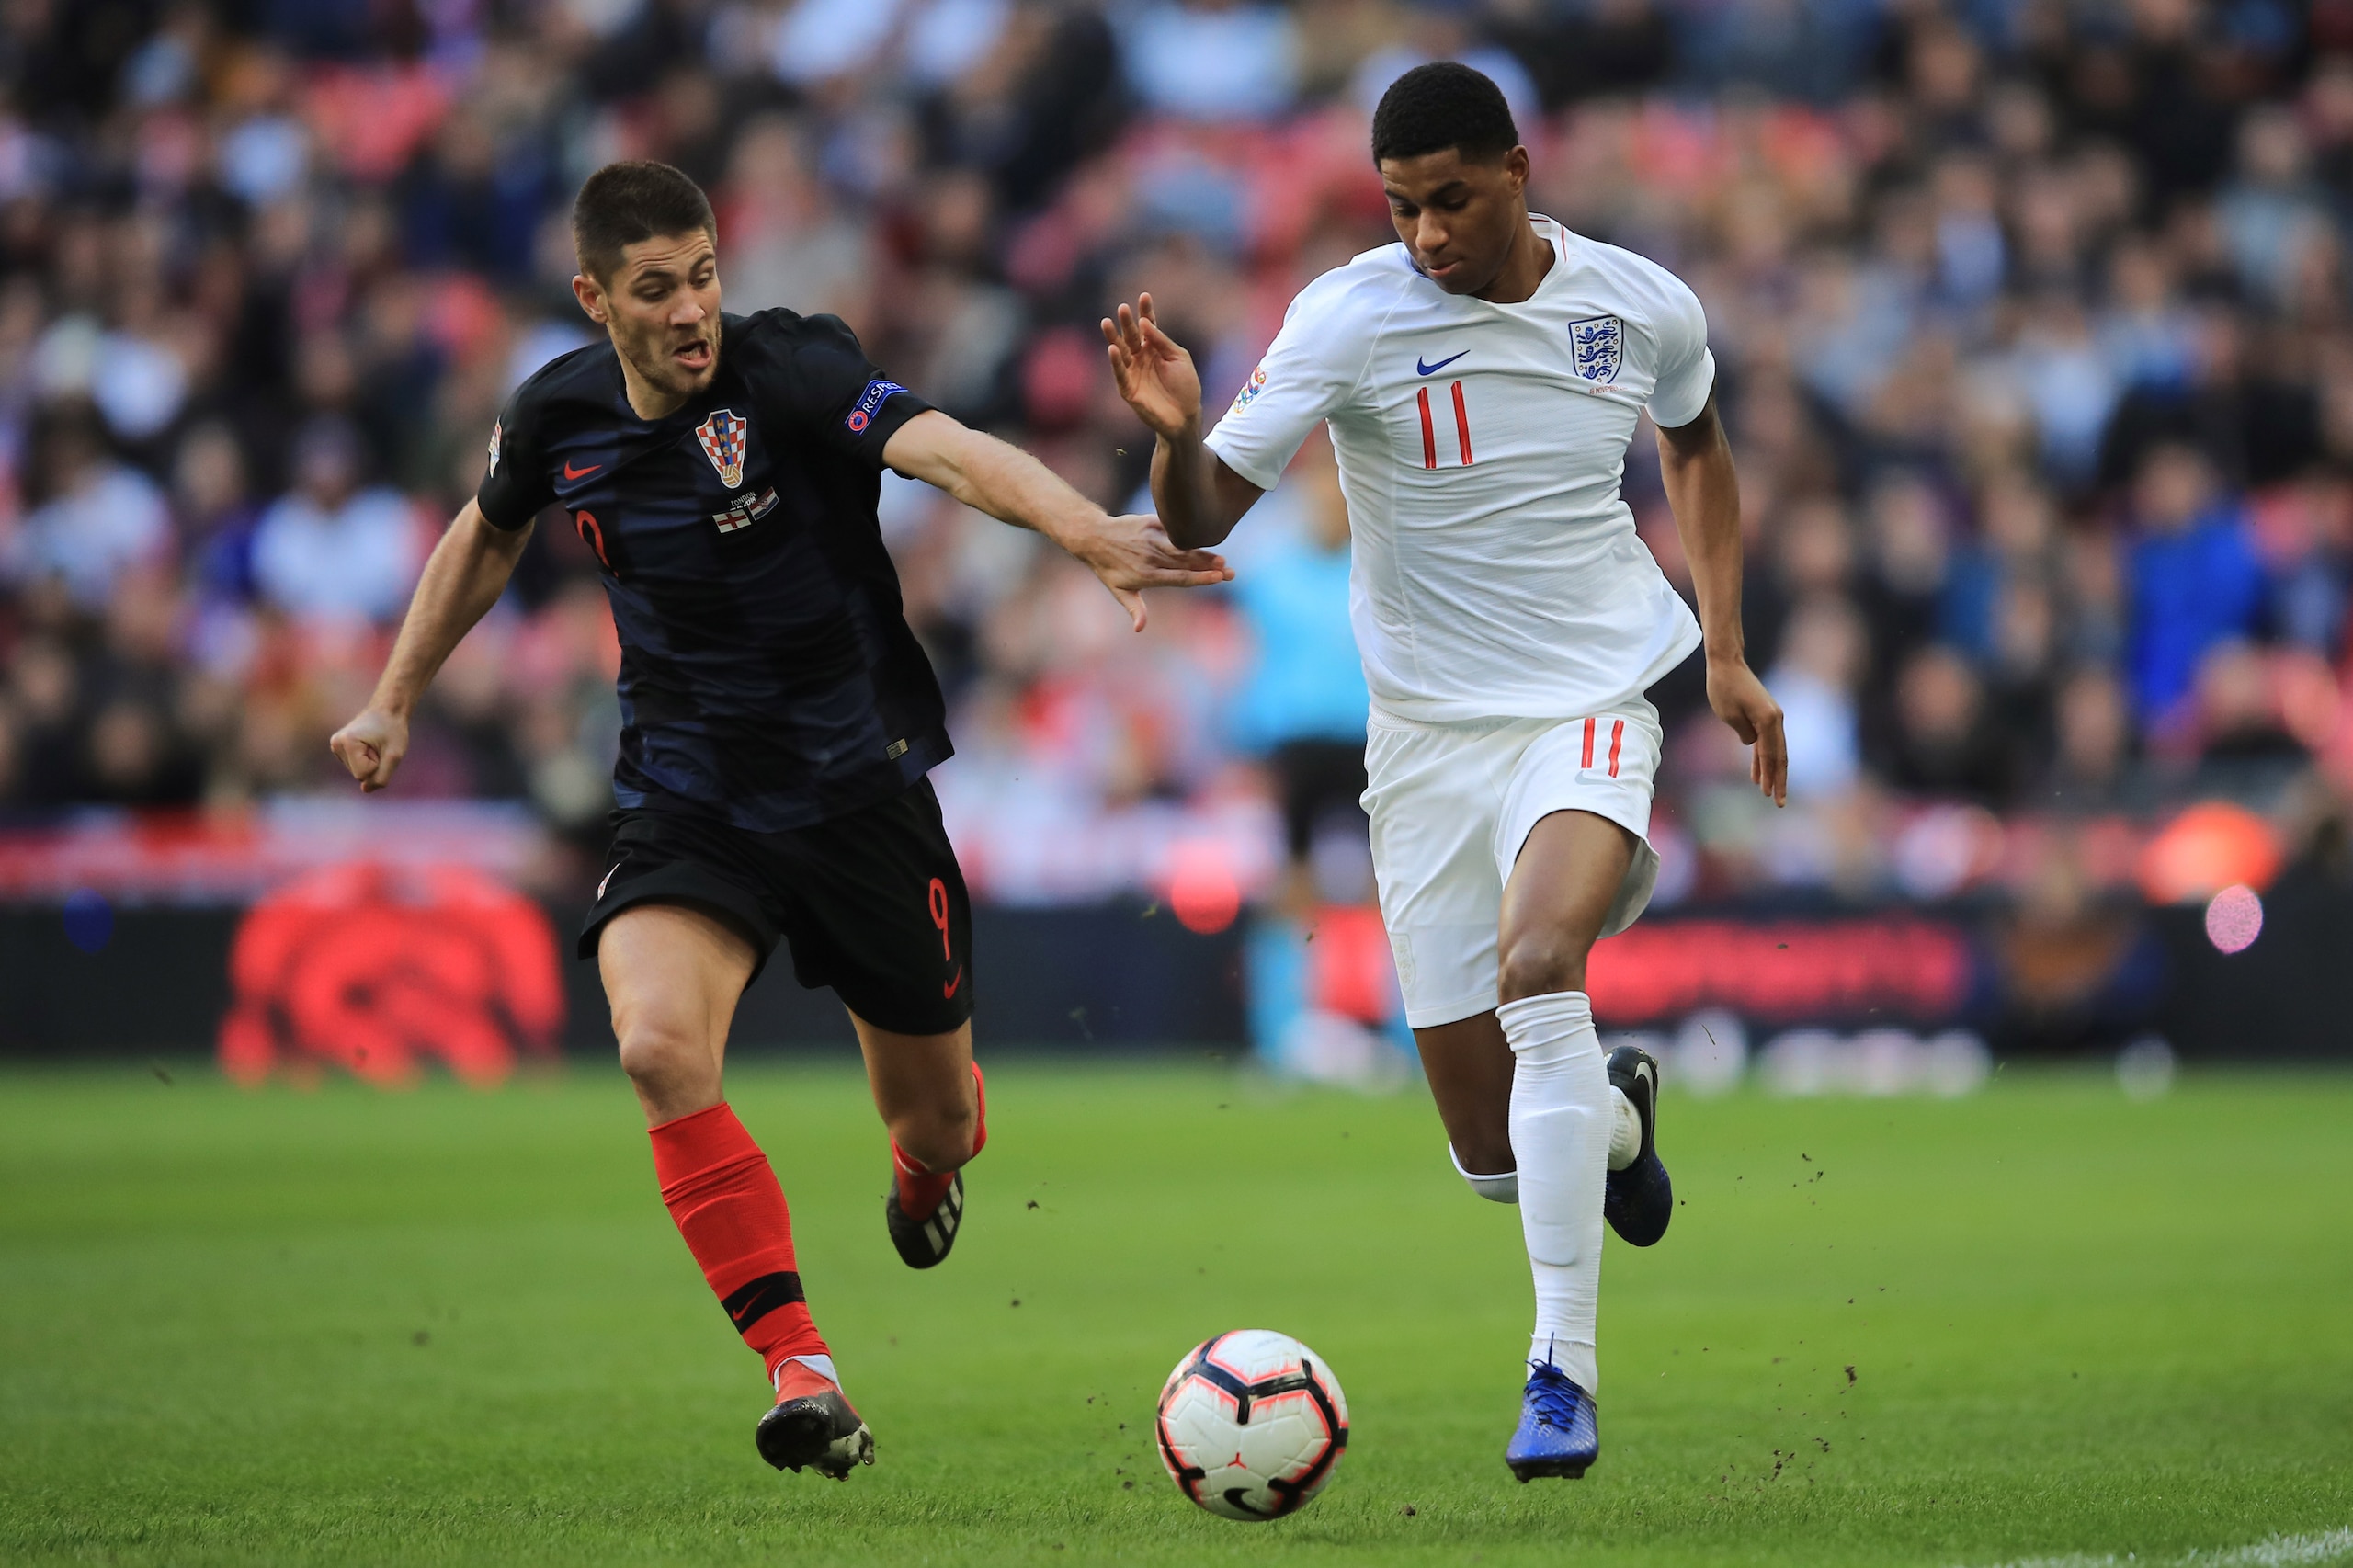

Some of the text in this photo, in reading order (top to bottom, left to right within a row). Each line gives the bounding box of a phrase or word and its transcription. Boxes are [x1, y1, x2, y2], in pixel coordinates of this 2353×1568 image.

[716, 419, 731, 458] HNS
[1417, 380, 1473, 469] 11
[731, 491, 756, 507] LONDON
[1581, 717, 1624, 779] 11
[928, 877, 950, 961] 9
